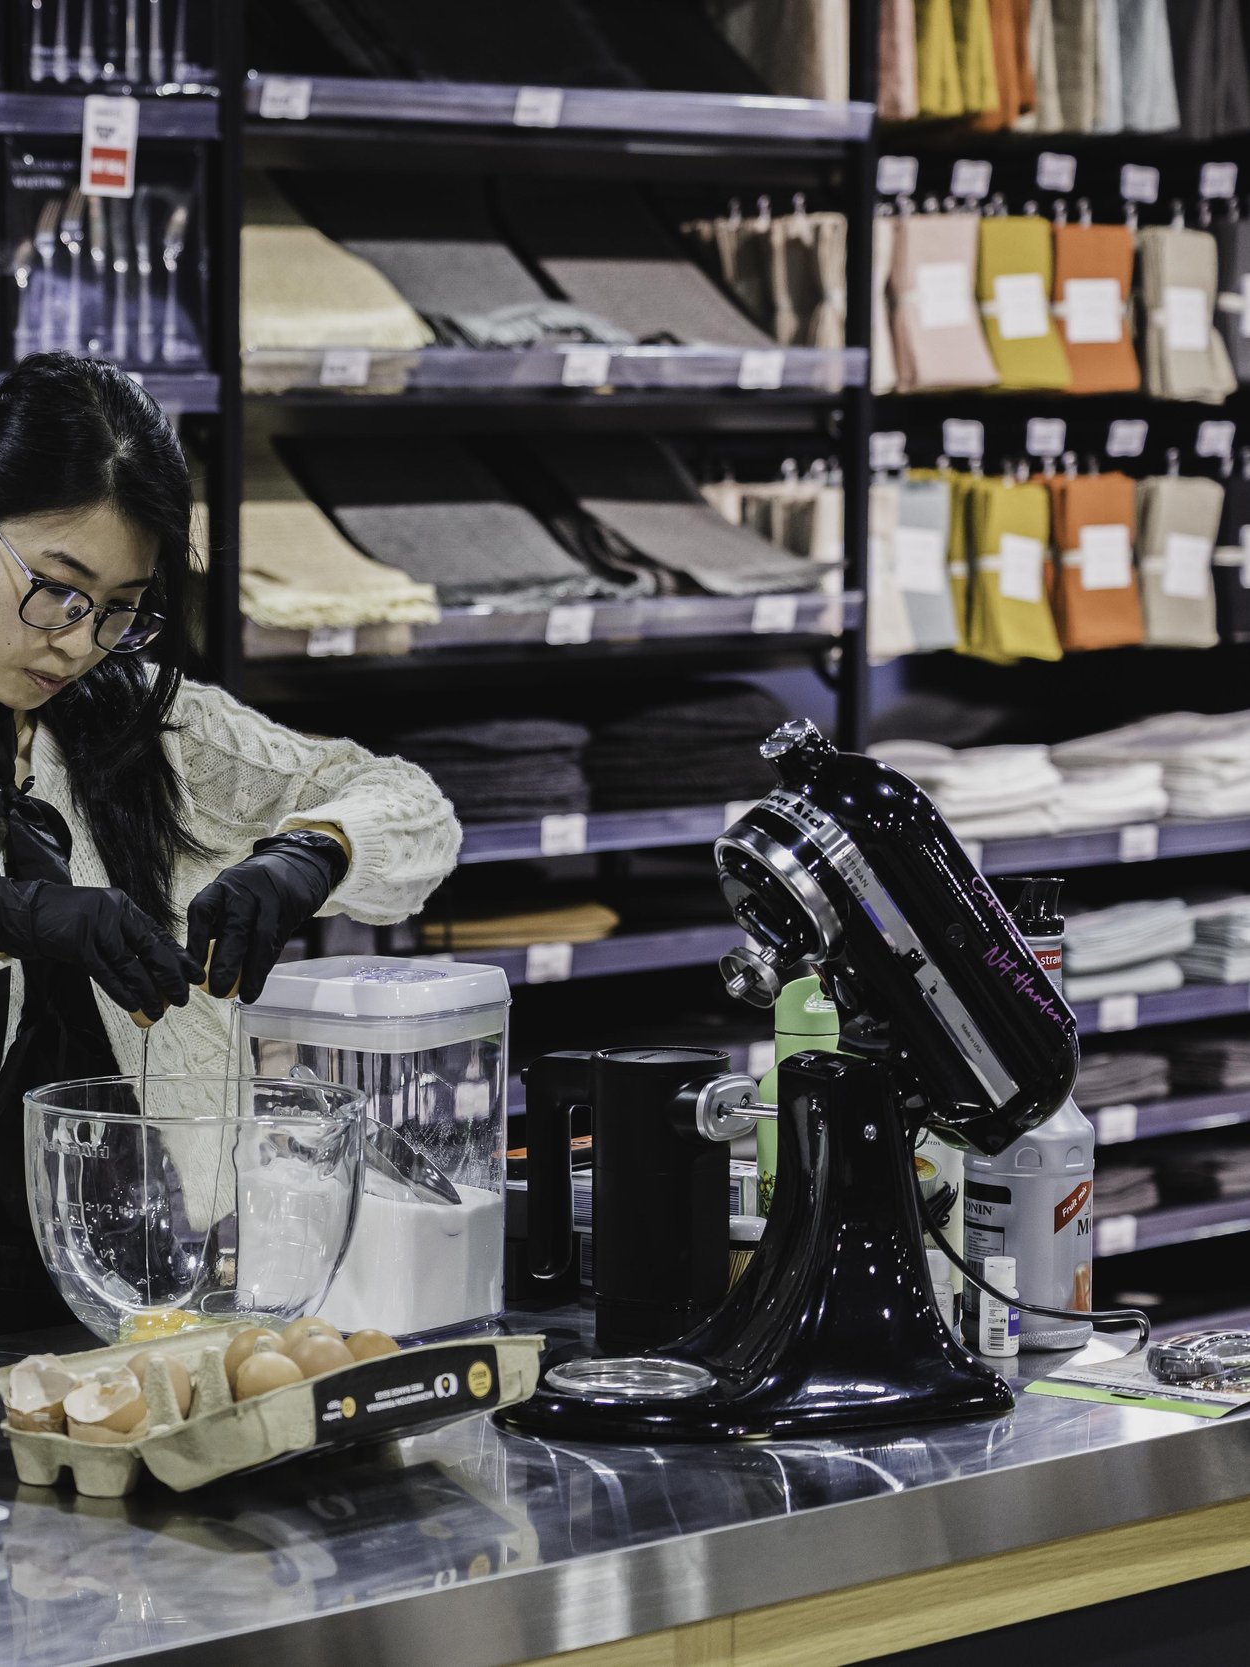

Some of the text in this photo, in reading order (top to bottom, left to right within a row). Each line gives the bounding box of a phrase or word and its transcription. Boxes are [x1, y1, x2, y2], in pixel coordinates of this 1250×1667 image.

[982, 945, 1072, 1030] Not Harder!
[1061, 1185, 1087, 1218] Fruit mix
